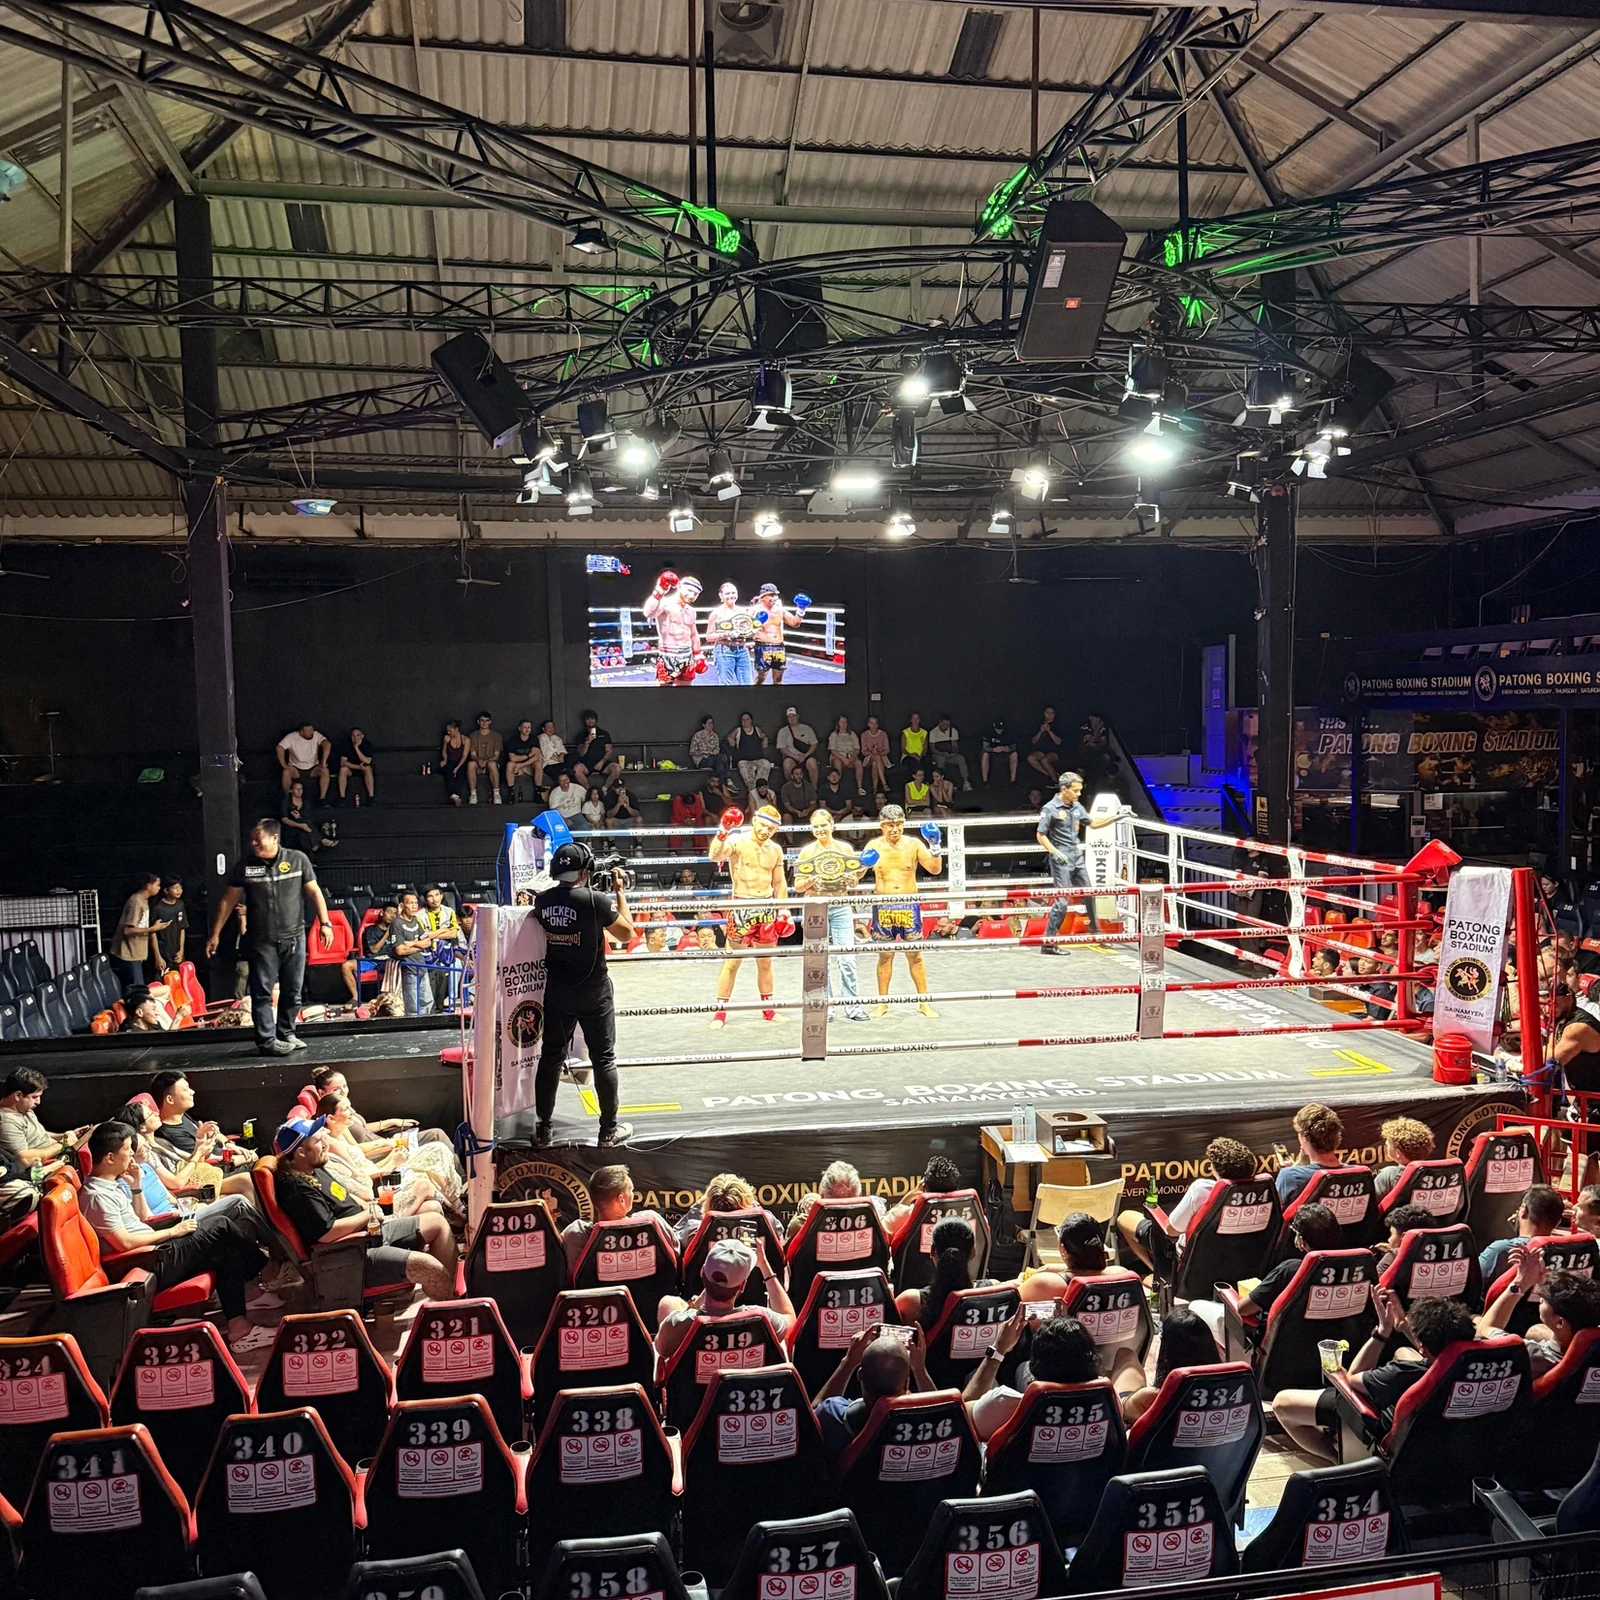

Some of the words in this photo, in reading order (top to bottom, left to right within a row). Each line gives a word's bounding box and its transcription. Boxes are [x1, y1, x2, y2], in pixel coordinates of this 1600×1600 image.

[1361, 679, 1393, 690] PATONG
[1396, 677, 1428, 689] BOXING
[1430, 676, 1472, 688] STADIUM
[1499, 674, 1542, 686] PATONG
[1546, 671, 1592, 685] BOXING
[1407, 731, 1478, 753] BOXING
[1095, 857, 1107, 887] KIN
[1029, 888, 1083, 898] TOPKING
[1084, 886, 1128, 896] BOXING
[1227, 881, 1279, 890] TOPKING
[1281, 879, 1324, 887] BOXING
[628, 904, 668, 913] PKING
[671, 902, 719, 911] BOXING
[828, 897, 879, 907] TOPKING
[881, 894, 928, 904] BOXING
[541, 905, 577, 920] WICKED
[549, 916, 569, 927] ONE
[1240, 928, 1289, 936] TOPKING
[1291, 926, 1333, 934] BOXING
[1448, 919, 1501, 936] PATONG
[1041, 935, 1095, 945] TOPKING
[1097, 933, 1140, 943] BOXING
[1450, 930, 1497, 945] BOXING
[1450, 941, 1494, 954] STADIUM
[502, 959, 546, 977] PATONG
[504, 970, 546, 988] BOXING
[506, 982, 545, 998] STADIUM
[619, 1007, 669, 1017] BOXING
[669, 1004, 726, 1015] TOPKING
[1444, 1005, 1485, 1018] SAINAMYEN
[894, 1042, 939, 1052] BOXING
[1041, 1036, 1093, 1045] TOPKING
[1095, 1033, 1140, 1043] BOXING
[701, 1088, 885, 1108] PATONG
[903, 1078, 1079, 1097] BOXING
[1095, 1070, 1294, 1087] STADIUM
[882, 1089, 1051, 1106] SAINAMYEN
[1056, 1089, 1108, 1097] RD.
[1446, 1118, 1474, 1158] ATONG
[1494, 1143, 1529, 1160] 301
[1120, 1157, 1213, 1182] PATONG
[1422, 1172, 1460, 1189] 302
[506, 1164, 556, 1182] BOXING
[558, 1172, 592, 1221] STADIUM
[1119, 1187, 1149, 1198] EVERY
[1157, 1184, 1190, 1195] MONDA
[1231, 1189, 1269, 1206] 304
[1329, 1182, 1365, 1198] 303
[492, 1213, 537, 1233] 309
[824, 1214, 867, 1231] 306
[930, 1206, 973, 1223] 305
[603, 1231, 649, 1249] 308
[716, 1225, 742, 1240] 30
[1423, 1240, 1464, 1261] 314
[1549, 1252, 1591, 1270] 313
[1320, 1265, 1365, 1284] 315
[827, 1286, 875, 1308] 318
[1086, 1292, 1131, 1312] 316
[567, 1304, 619, 1328] 320
[966, 1304, 1011, 1325] 317
[429, 1316, 481, 1340] 321
[293, 1329, 347, 1353] 322
[704, 1331, 754, 1351] 319
[143, 1343, 201, 1366] 323
[1465, 1359, 1514, 1380] 333
[728, 1386, 785, 1413] 337
[1191, 1384, 1245, 1407] 334
[571, 1407, 634, 1433] 338
[1044, 1403, 1105, 1425] 335
[409, 1418, 472, 1446] 339
[233, 1431, 303, 1461] 340
[56, 1450, 128, 1480] 341
[1137, 1496, 1206, 1529] 355
[1317, 1488, 1381, 1522] 354
[958, 1519, 1030, 1552] 356
[768, 1540, 841, 1574] 357
[569, 1566, 650, 1600] 358
